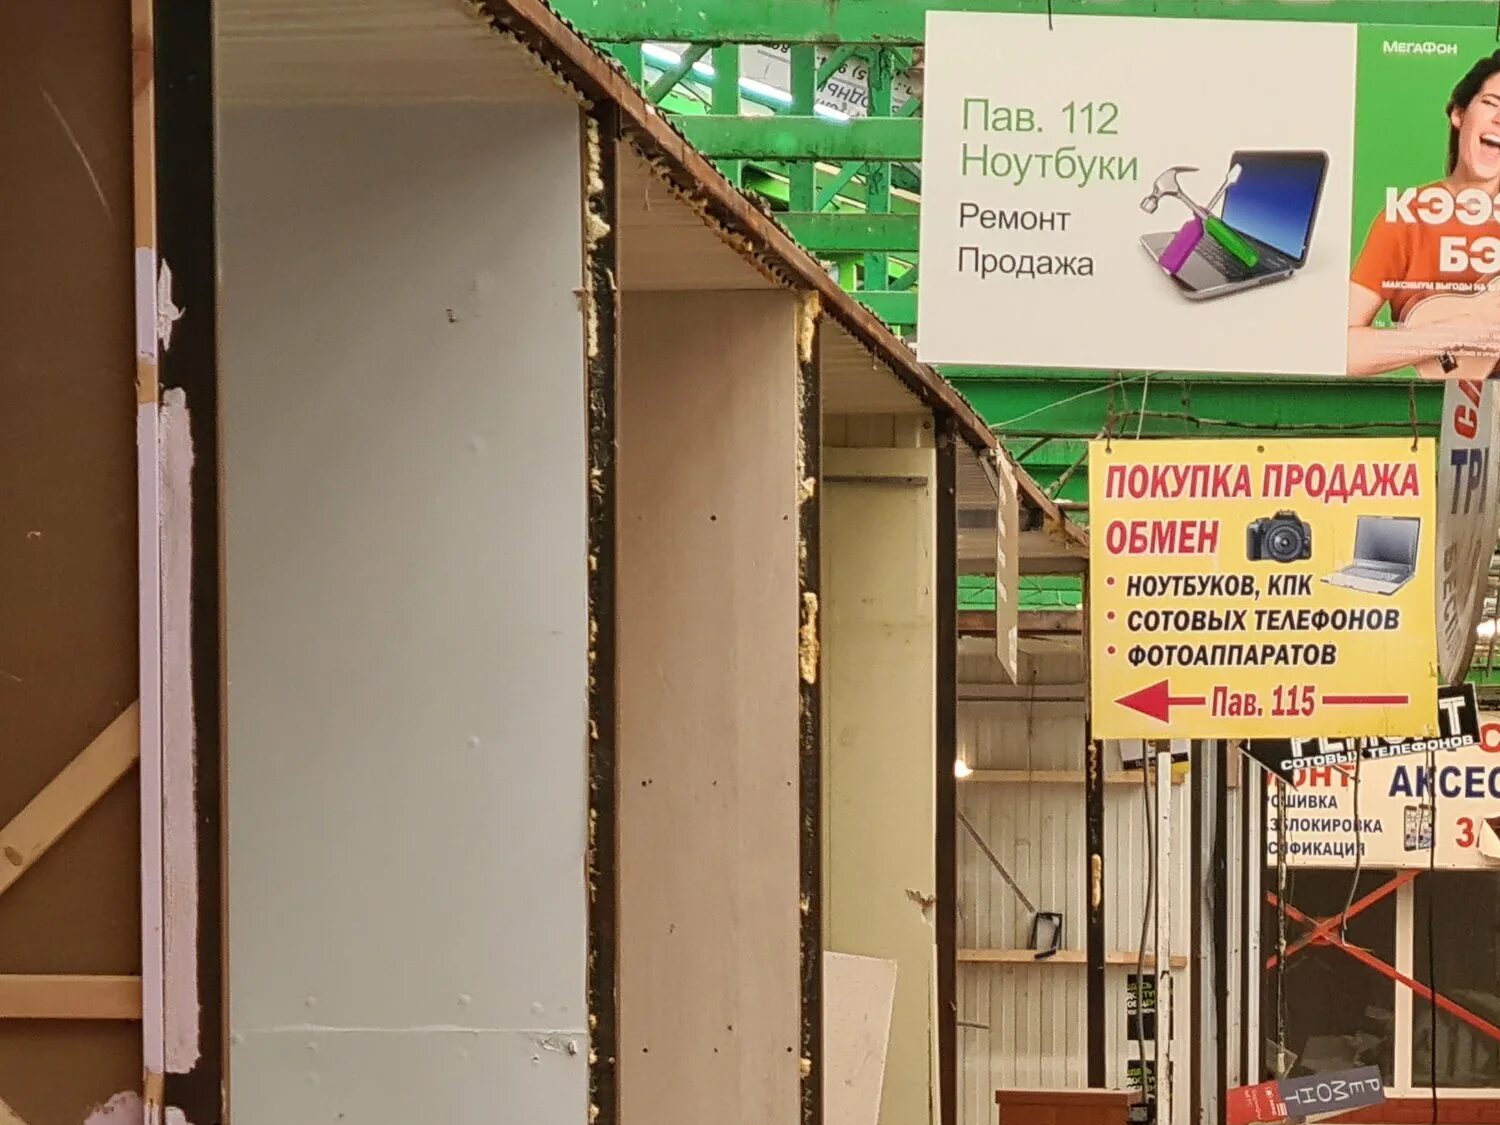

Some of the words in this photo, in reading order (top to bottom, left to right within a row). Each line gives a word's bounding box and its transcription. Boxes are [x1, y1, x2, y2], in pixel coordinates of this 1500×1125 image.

[963, 98, 1043, 132] Пав.
[1062, 101, 1118, 135] 112
[962, 143, 1138, 188] Ноутбуки
[960, 202, 1071, 231] Ремонт
[958, 246, 1094, 280] Продажа
[1105, 464, 1252, 499] ПОКУПКА
[1262, 463, 1419, 504] ПРОДАЖА
[1106, 520, 1219, 555] ОБМЕН
[1127, 575, 1260, 600] НОУТБУКОВ,
[1267, 574, 1313, 596] КПК
[1127, 609, 1247, 631] СОТОВЫХ
[1254, 609, 1400, 631] ТЕЛЕФОНОВ
[1128, 644, 1337, 667] ФОТОАППАРАТОВ
[1211, 686, 1263, 716] Пав.
[1272, 685, 1316, 716] 115
[1368, 734, 1474, 760] ТЕЛЕФОНОВ
[1267, 795, 1338, 809] ОШИВКА
